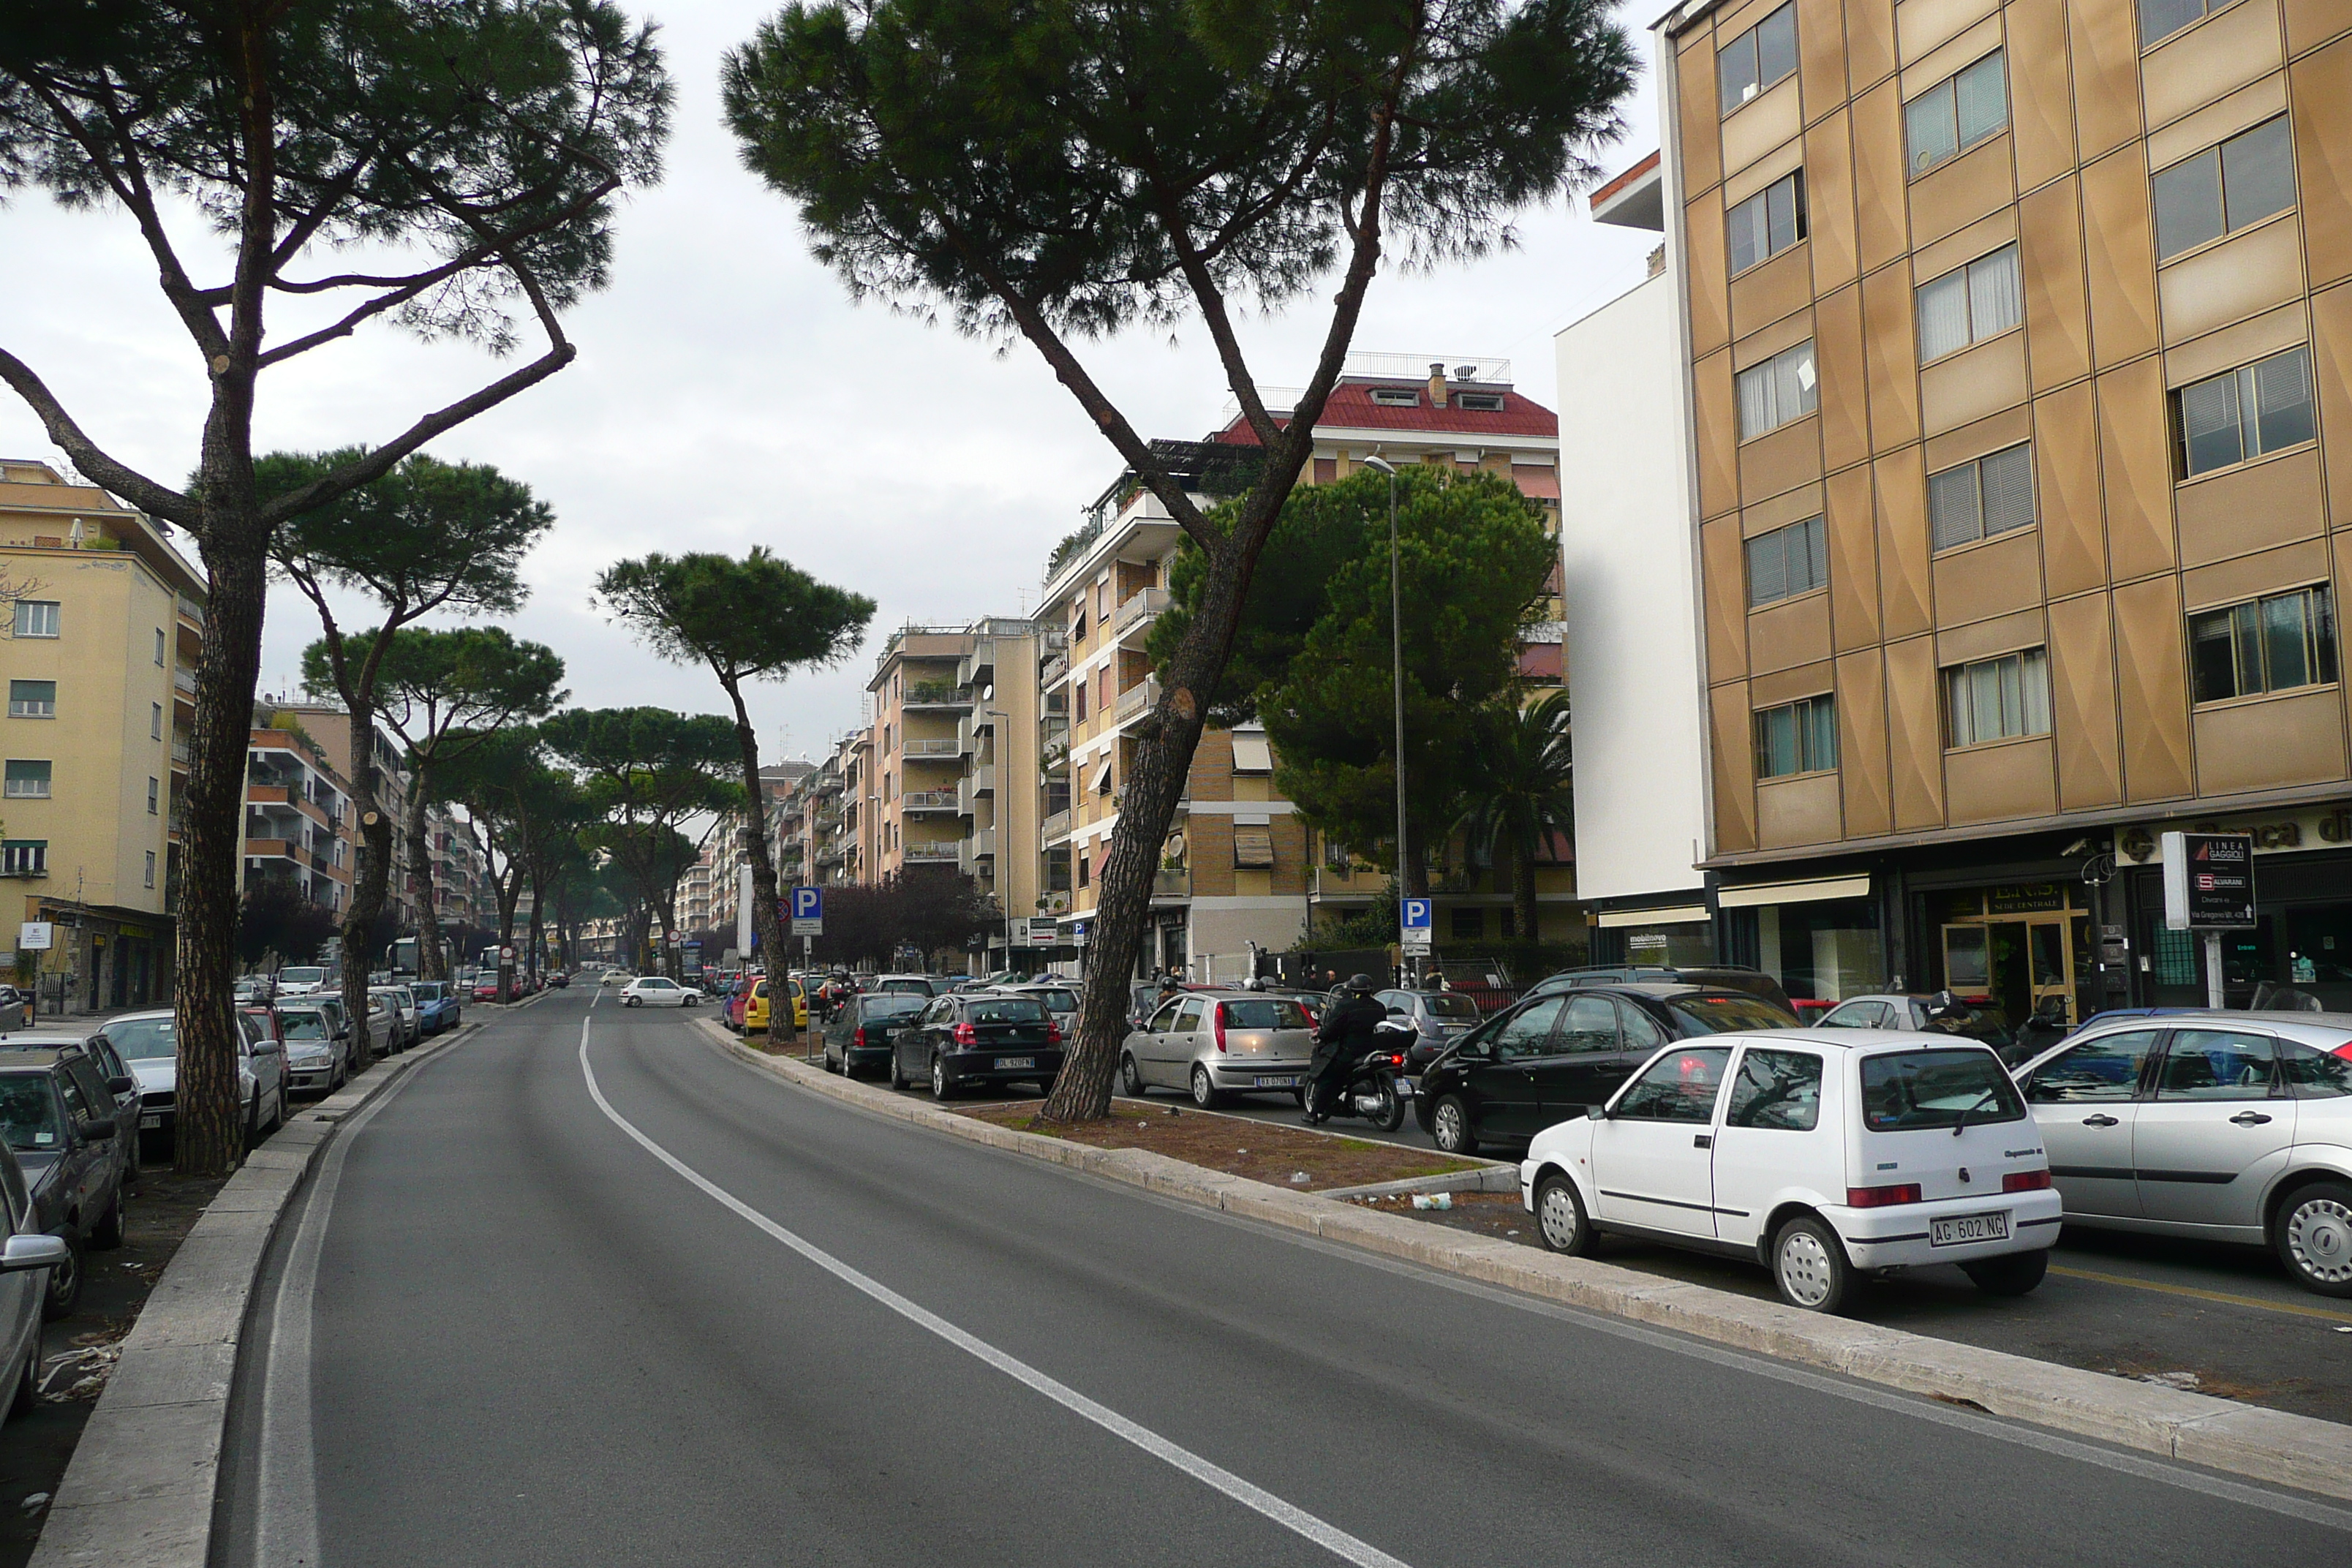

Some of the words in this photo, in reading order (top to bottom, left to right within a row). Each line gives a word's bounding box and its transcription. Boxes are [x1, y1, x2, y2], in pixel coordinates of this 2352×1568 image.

[2209, 842, 2243, 850] LINEA
[2209, 851, 2244, 859] GAGGIOLI
[2198, 875, 2243, 888] SALVARANI
[798, 889, 817, 916] P
[2017, 900, 2058, 908] CENTRALE
[1408, 901, 1425, 926] P
[2201, 911, 2224, 919] Gregorio
[1075, 923, 1082, 934] P
[1935, 1224, 1951, 1241] AG
[1958, 1220, 1983, 1239] 602
[1987, 1217, 2003, 1237] NG
